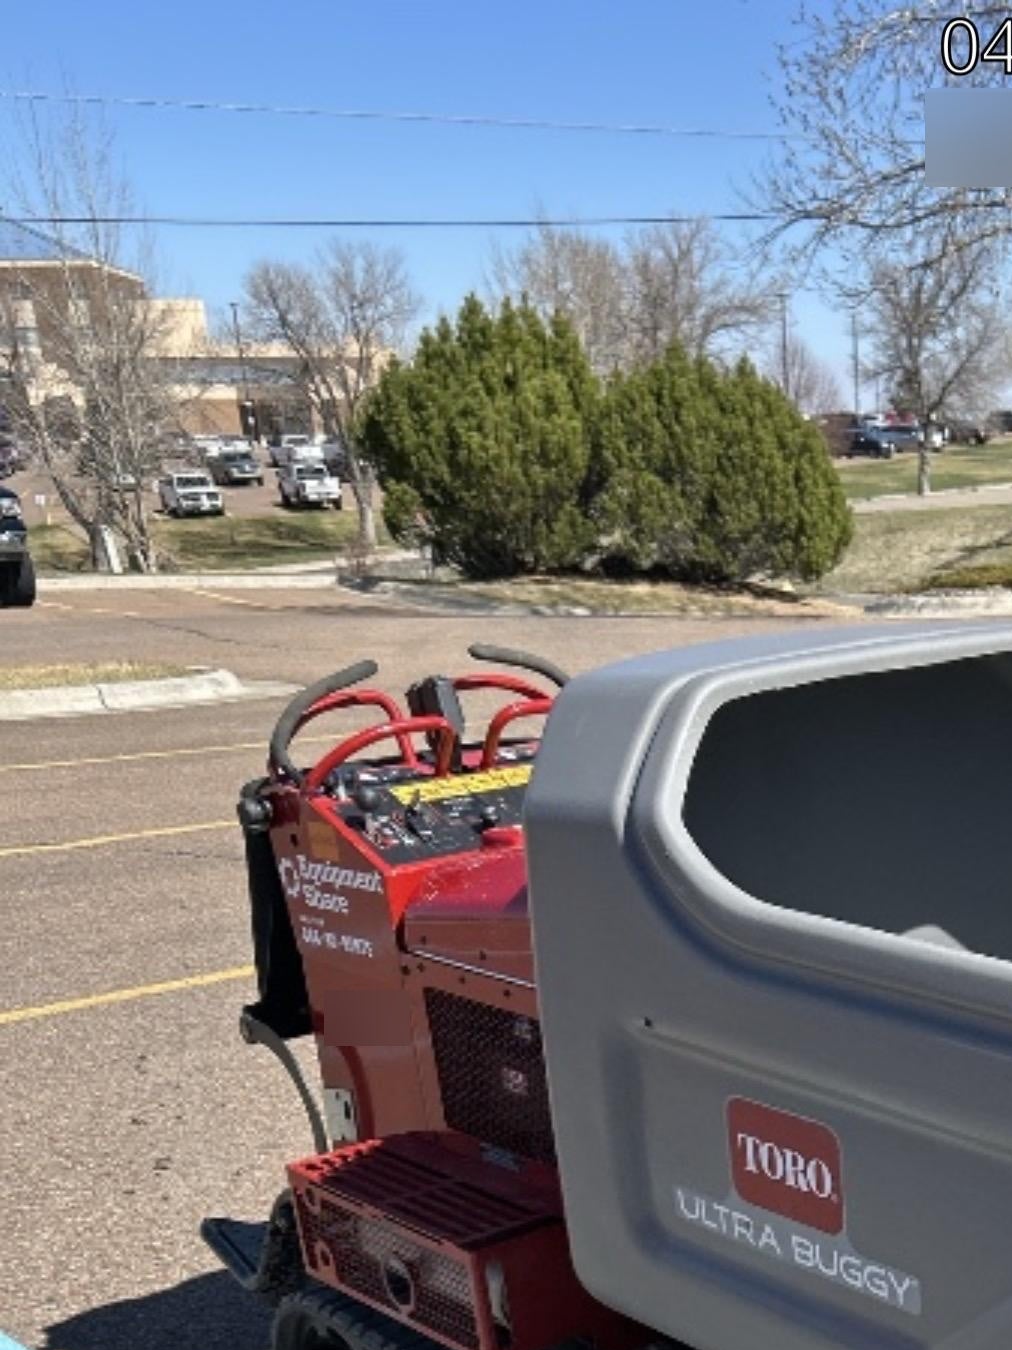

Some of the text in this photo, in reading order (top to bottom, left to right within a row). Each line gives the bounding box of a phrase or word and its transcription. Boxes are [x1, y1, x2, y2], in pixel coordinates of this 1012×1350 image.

[737, 1133, 833, 1199] TORO
[677, 1188, 911, 1306] ULTRA BUGGY
